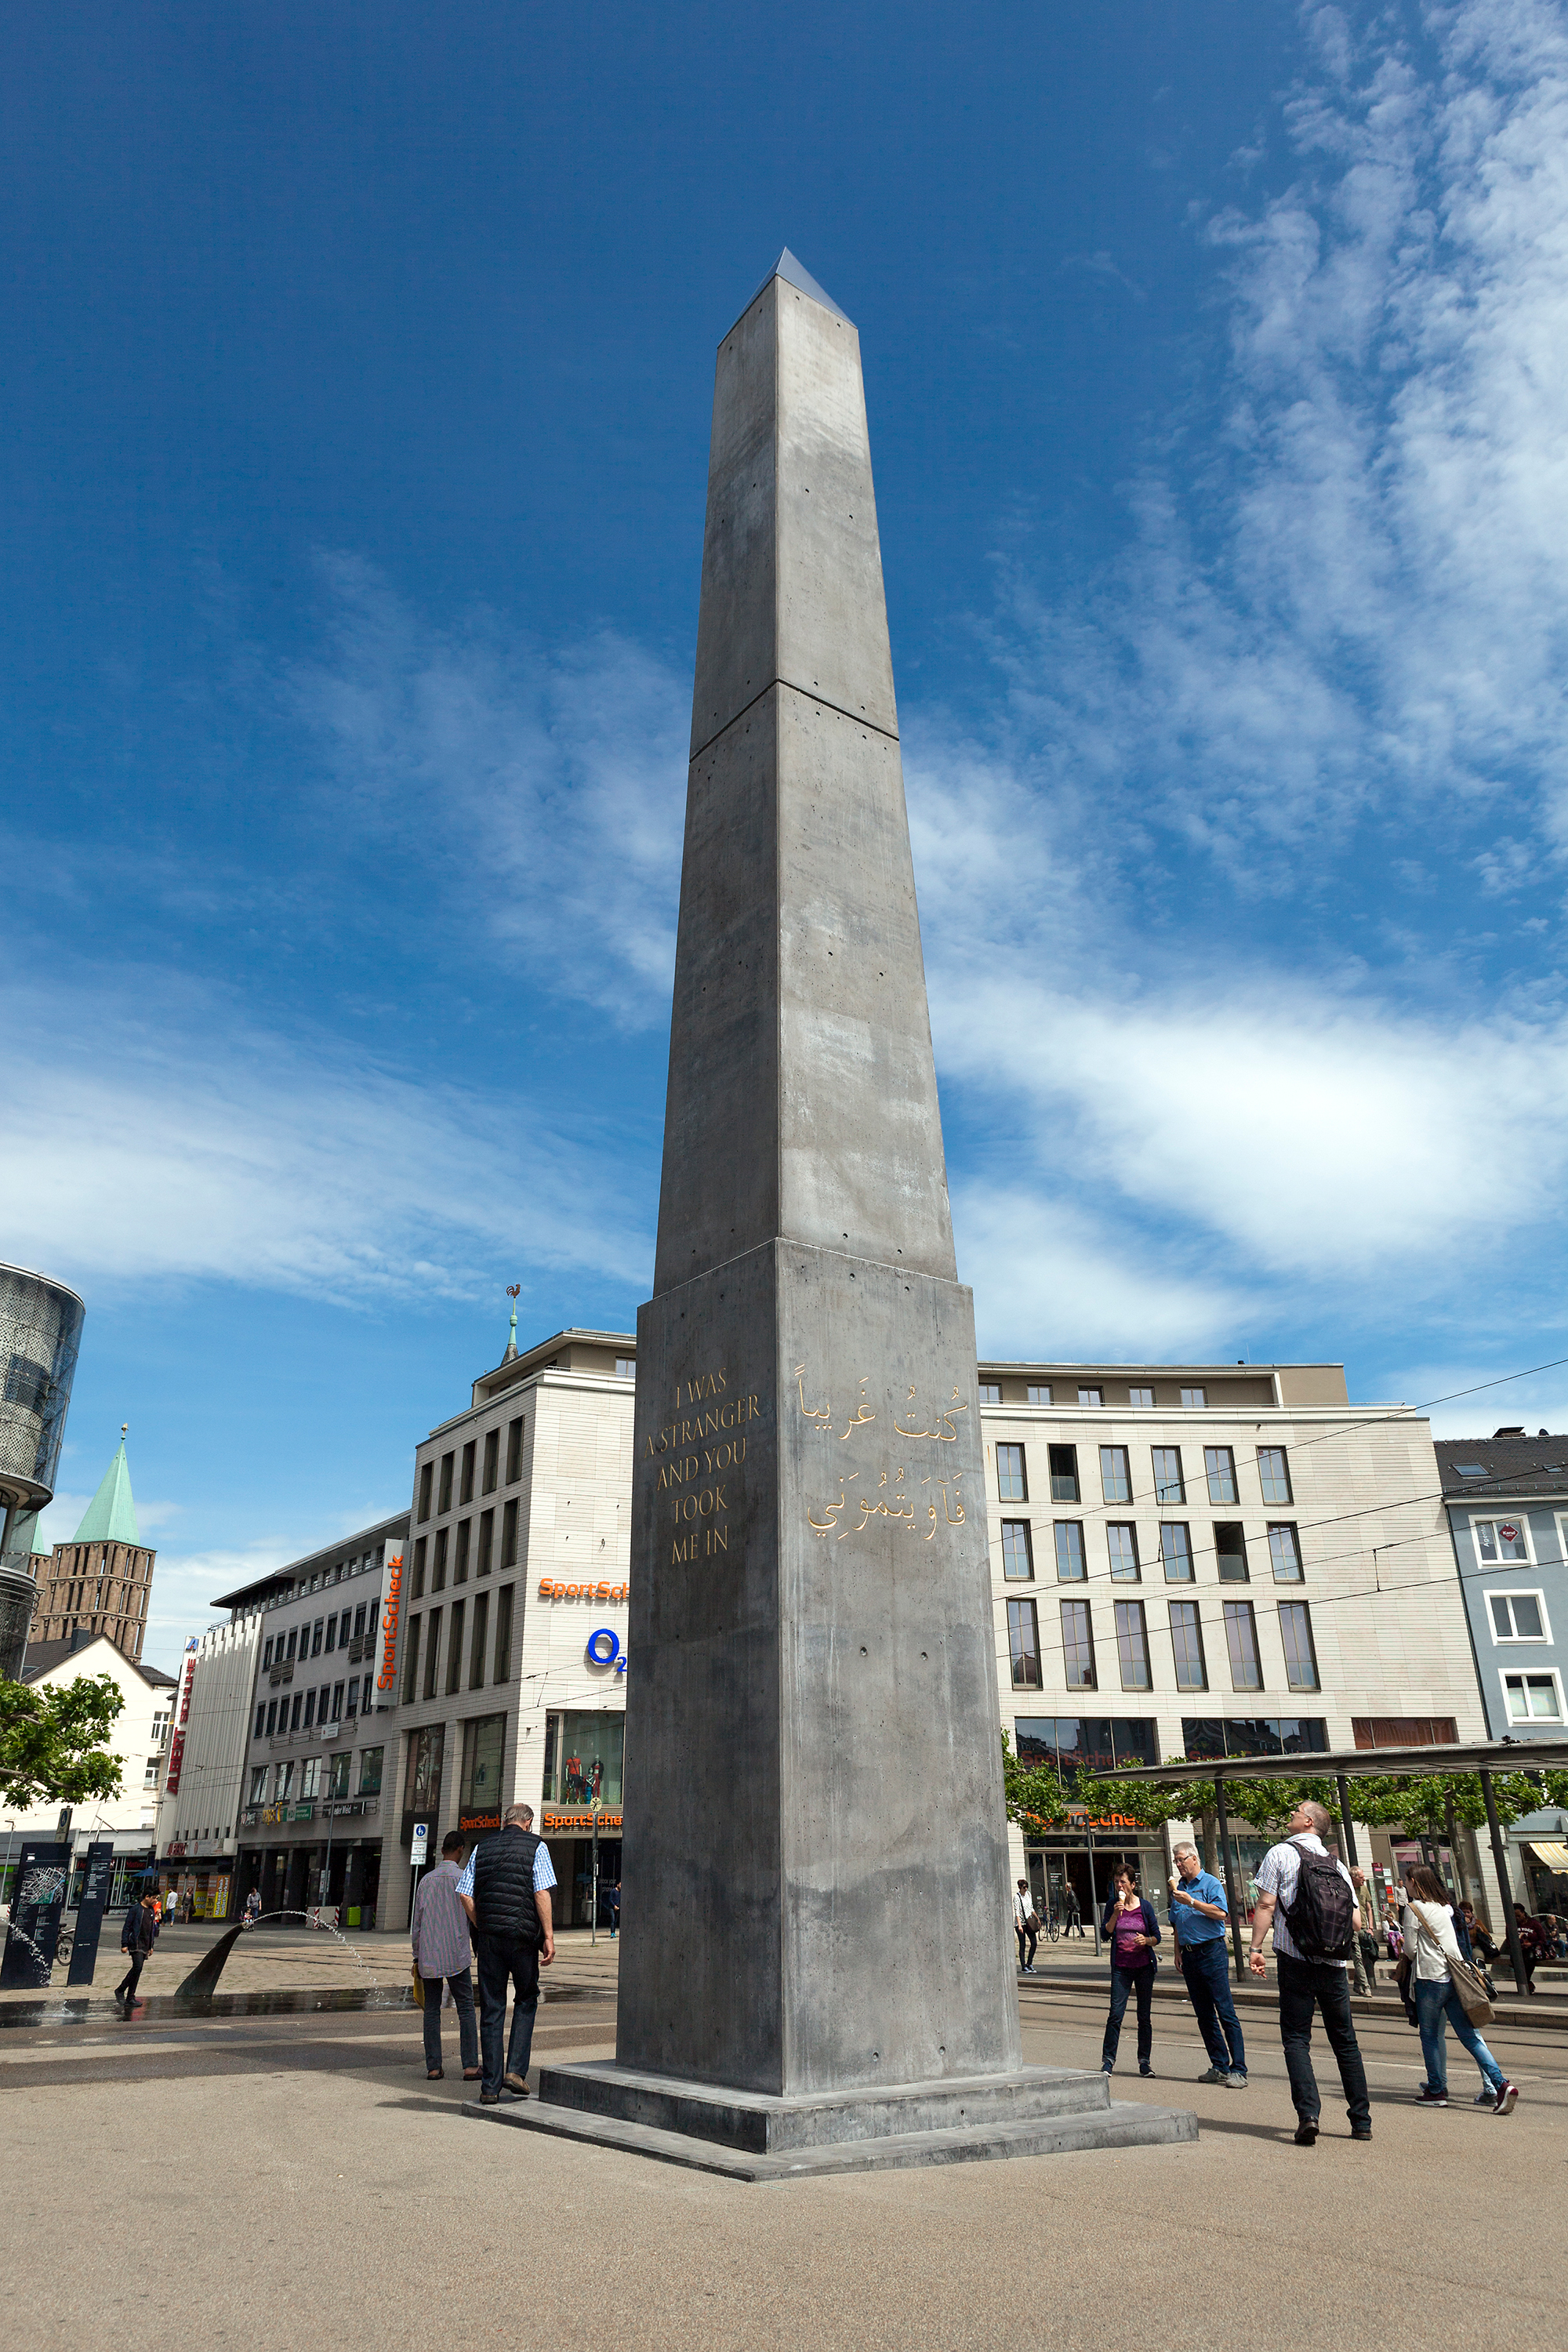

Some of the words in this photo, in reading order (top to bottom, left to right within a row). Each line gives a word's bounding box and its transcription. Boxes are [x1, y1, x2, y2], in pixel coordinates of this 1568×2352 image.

[676, 1386, 680, 1409] I
[688, 1367, 726, 1403] WAS
[644, 1436, 654, 1458] A
[661, 1395, 760, 1452] STRANGER
[657, 1456, 699, 1490] AND
[704, 1437, 746, 1473] YOU
[672, 1485, 728, 1523] TOOK
[672, 1534, 698, 1565] ME
[707, 1526, 728, 1555] IN
[378, 1555, 404, 1690] SportScheck
[166, 1727, 186, 1795] ALBERT
[180, 1658, 196, 1722] SCHUHE
[460, 1814, 500, 1831] SportScheck
